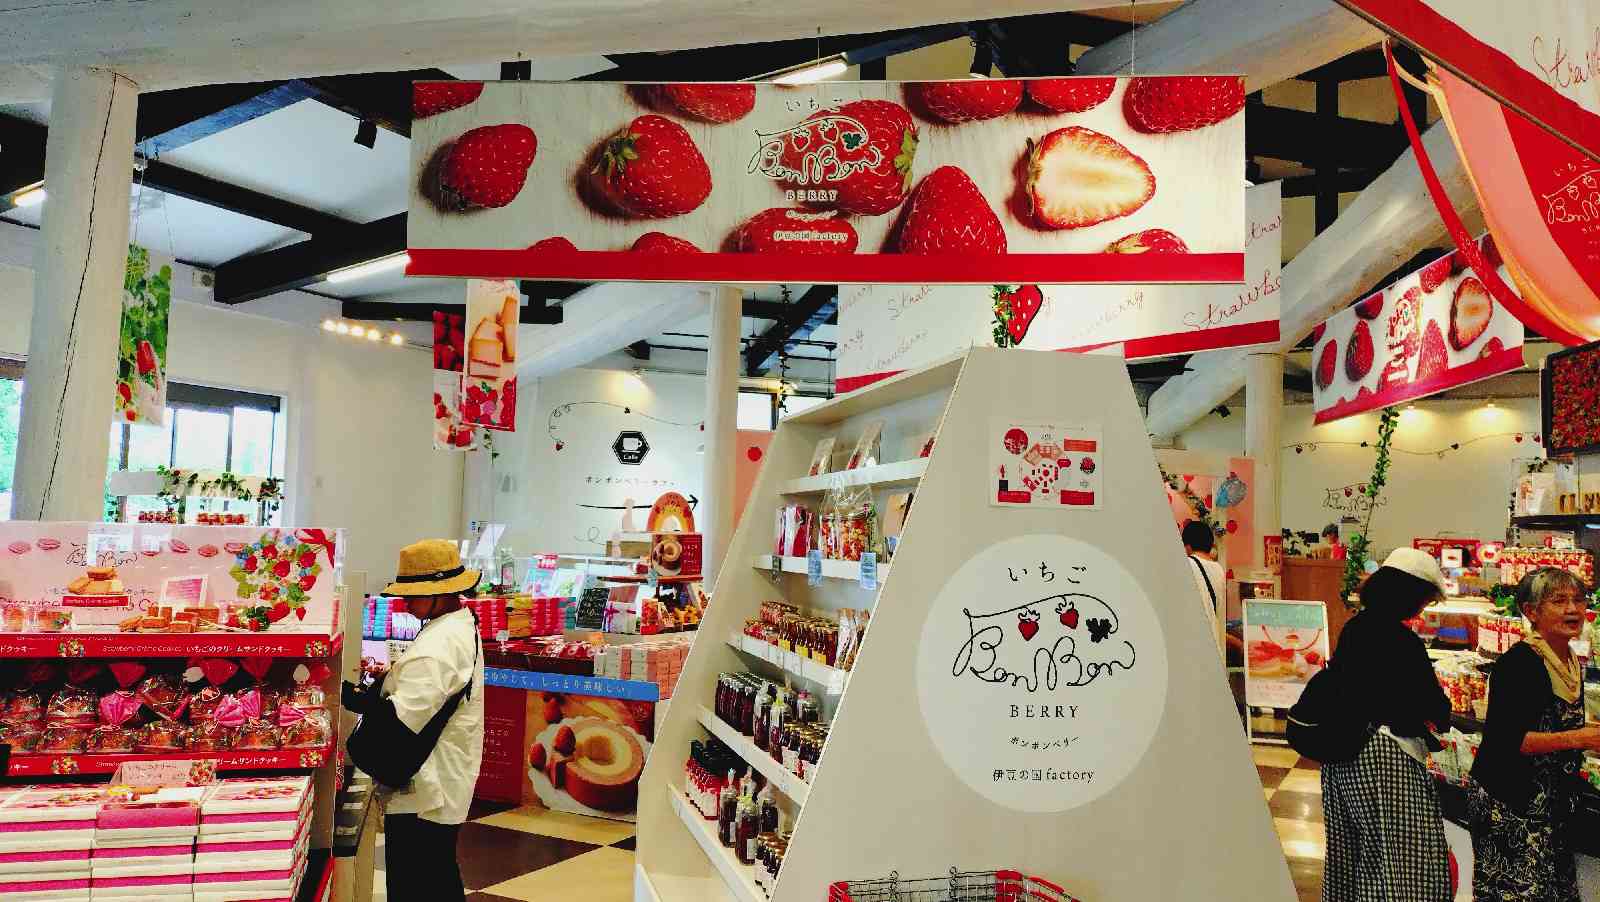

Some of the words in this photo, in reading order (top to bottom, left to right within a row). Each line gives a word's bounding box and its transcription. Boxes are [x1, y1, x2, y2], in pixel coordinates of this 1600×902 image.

[786, 189, 838, 200] BERRY
[1007, 561, 1087, 583] いちご
[1009, 704, 1079, 718] BERRY
[1009, 735, 1080, 750] ボンボンベリー
[993, 768, 1042, 782] 伊豆の国
[1045, 767, 1095, 783] factory
